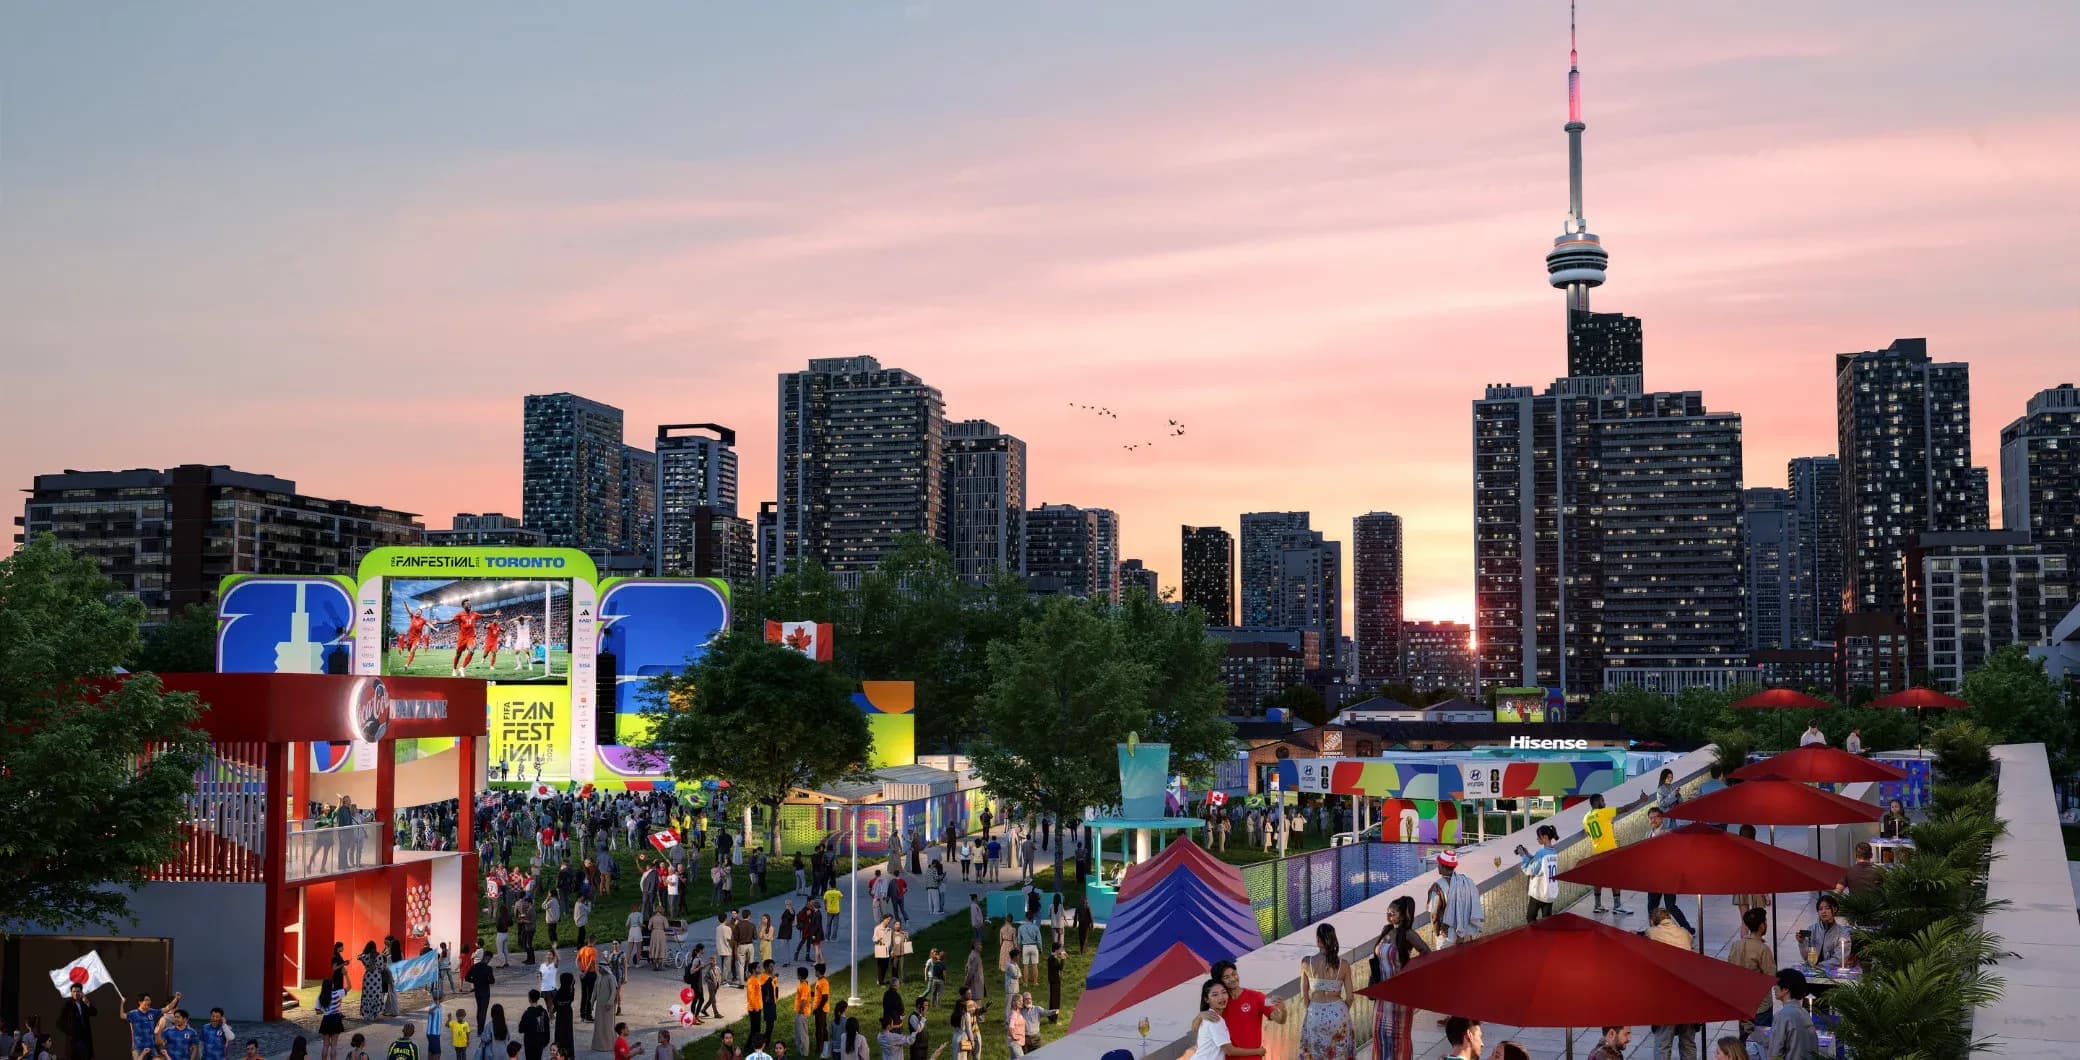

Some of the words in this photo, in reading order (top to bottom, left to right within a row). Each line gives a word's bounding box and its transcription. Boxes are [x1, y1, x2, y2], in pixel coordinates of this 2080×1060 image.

[484, 556, 566, 568] TORONTO
[503, 701, 511, 720] FIFA
[512, 701, 554, 720] FAN
[503, 722, 555, 741] FEST
[1510, 735, 1588, 750] Hisense
[1588, 820, 1603, 840] 10
[1547, 864, 1557, 883] 10
